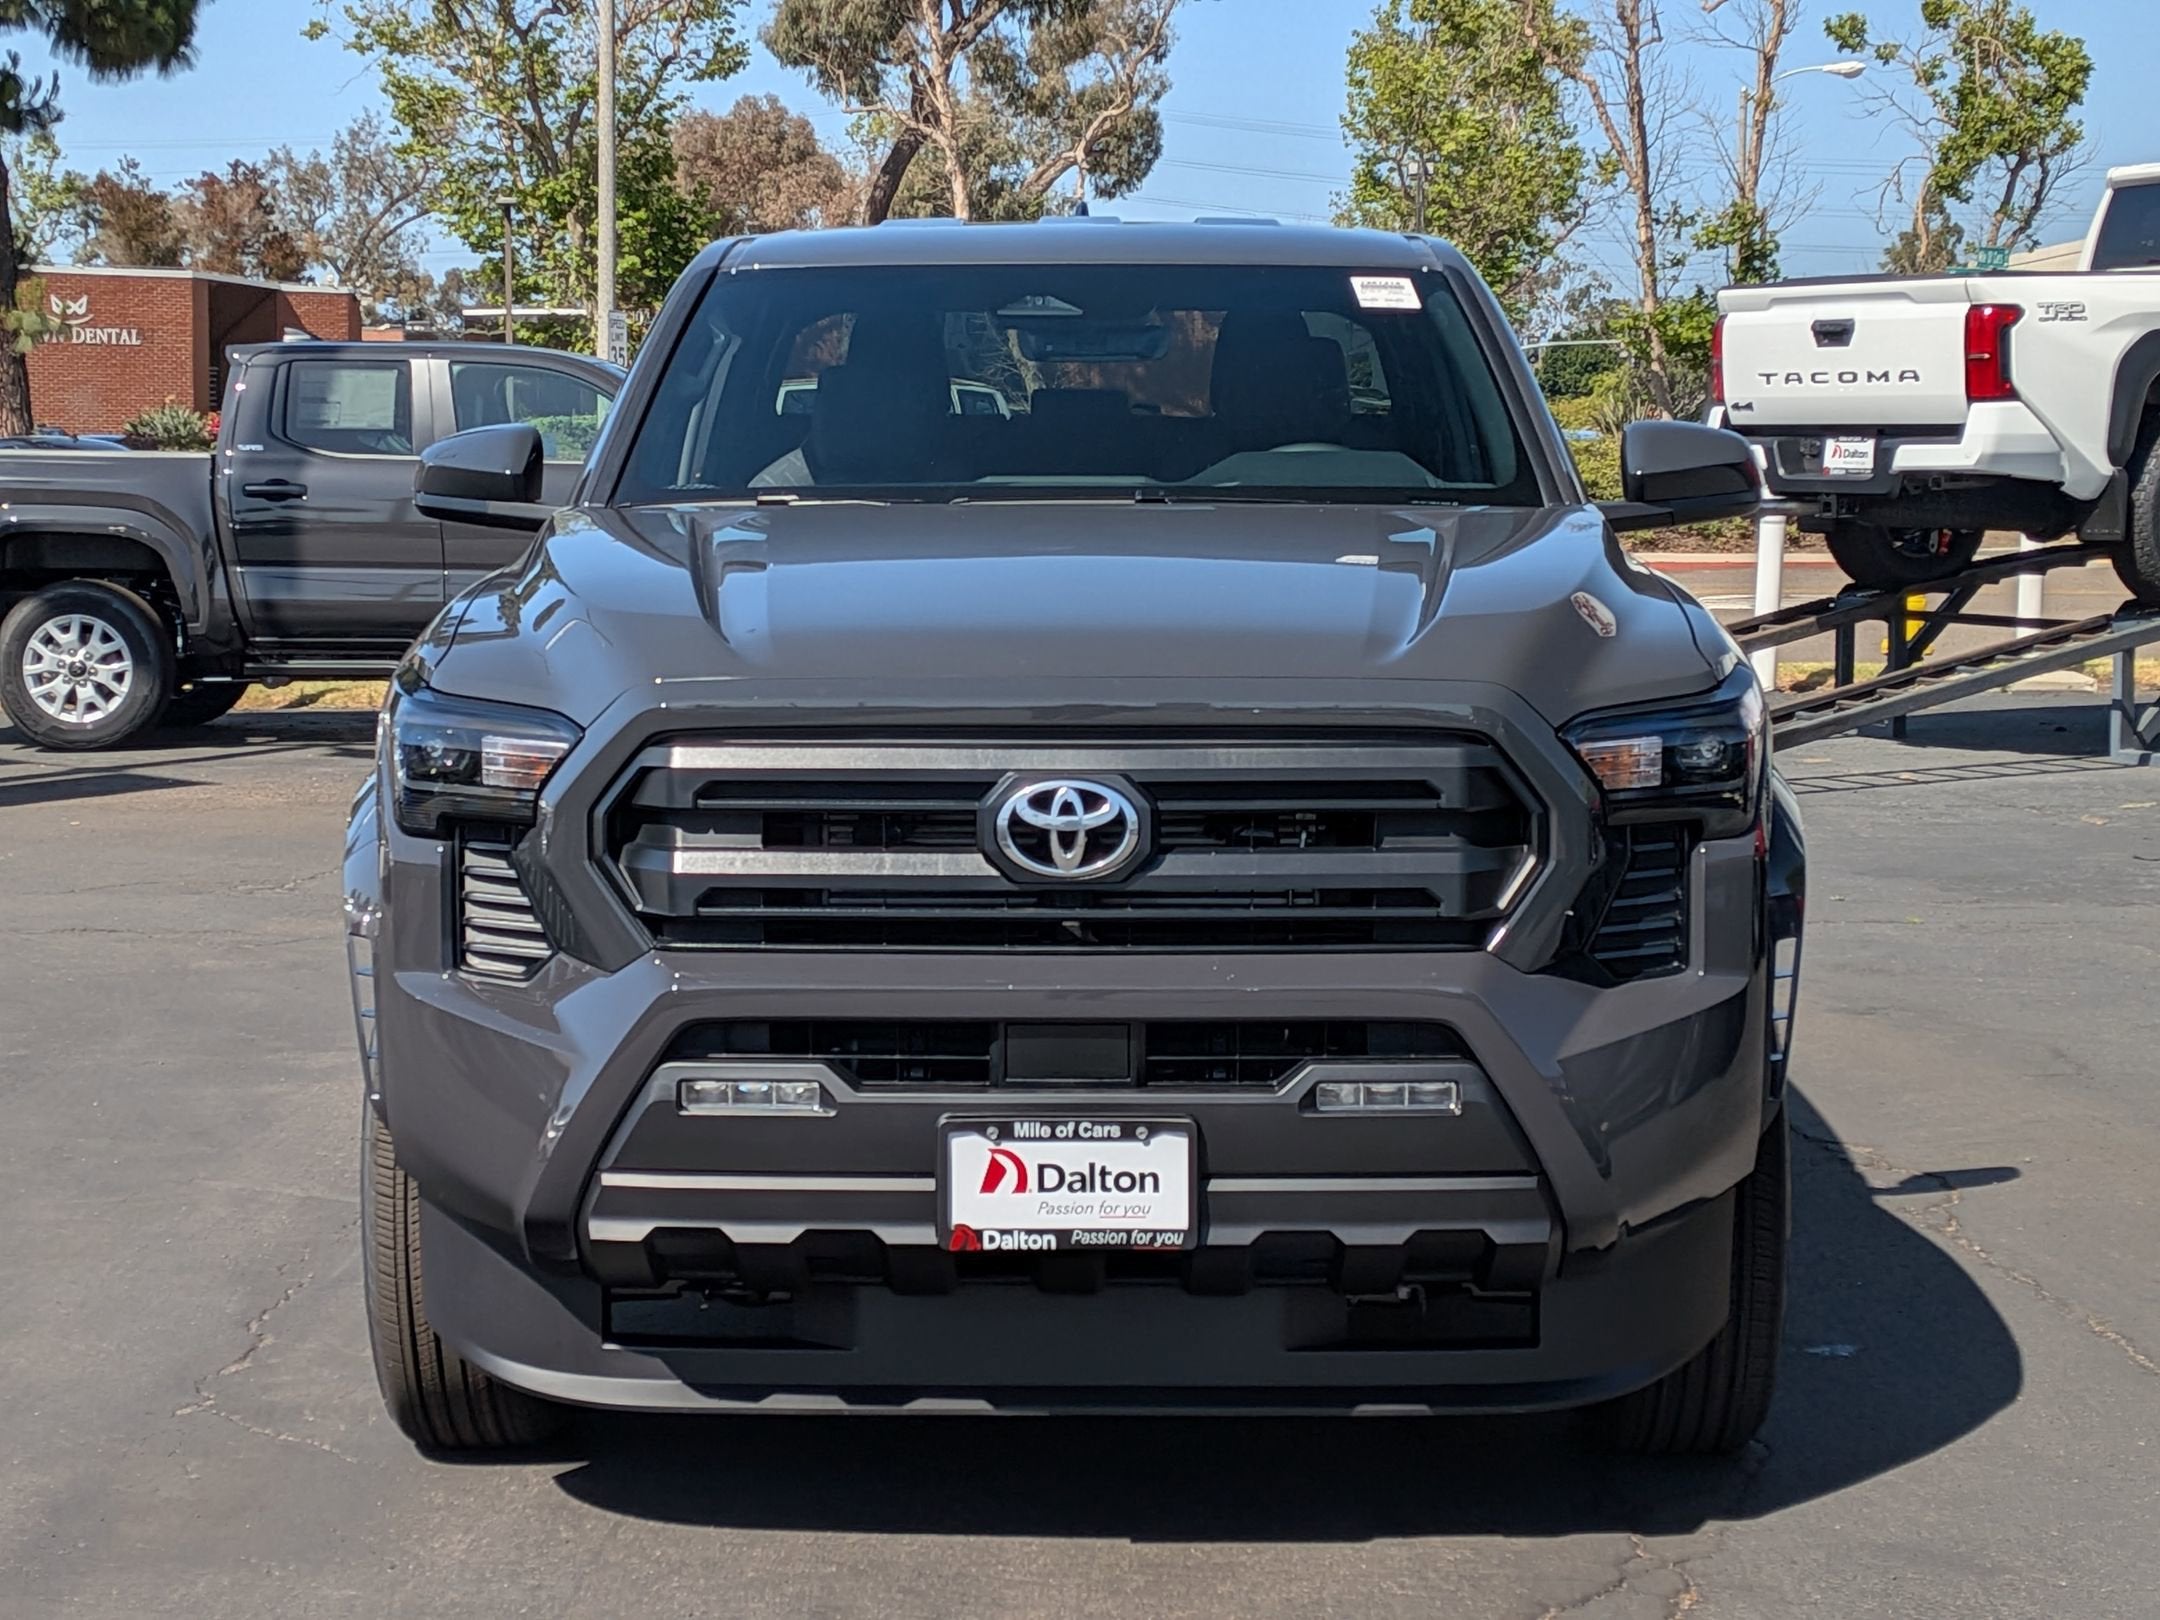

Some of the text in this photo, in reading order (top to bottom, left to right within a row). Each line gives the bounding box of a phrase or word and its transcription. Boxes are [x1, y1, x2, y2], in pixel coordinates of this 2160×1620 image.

[71, 326, 141, 345] DENTAL
[1758, 370, 1920, 385] TACOMA
[1014, 1121, 1121, 1138] Mile of Cars
[1036, 1162, 1161, 1194] Dalton
[1036, 1200, 1152, 1218] Passion for you
[982, 1229, 1184, 1250] Dalton Passion for you
